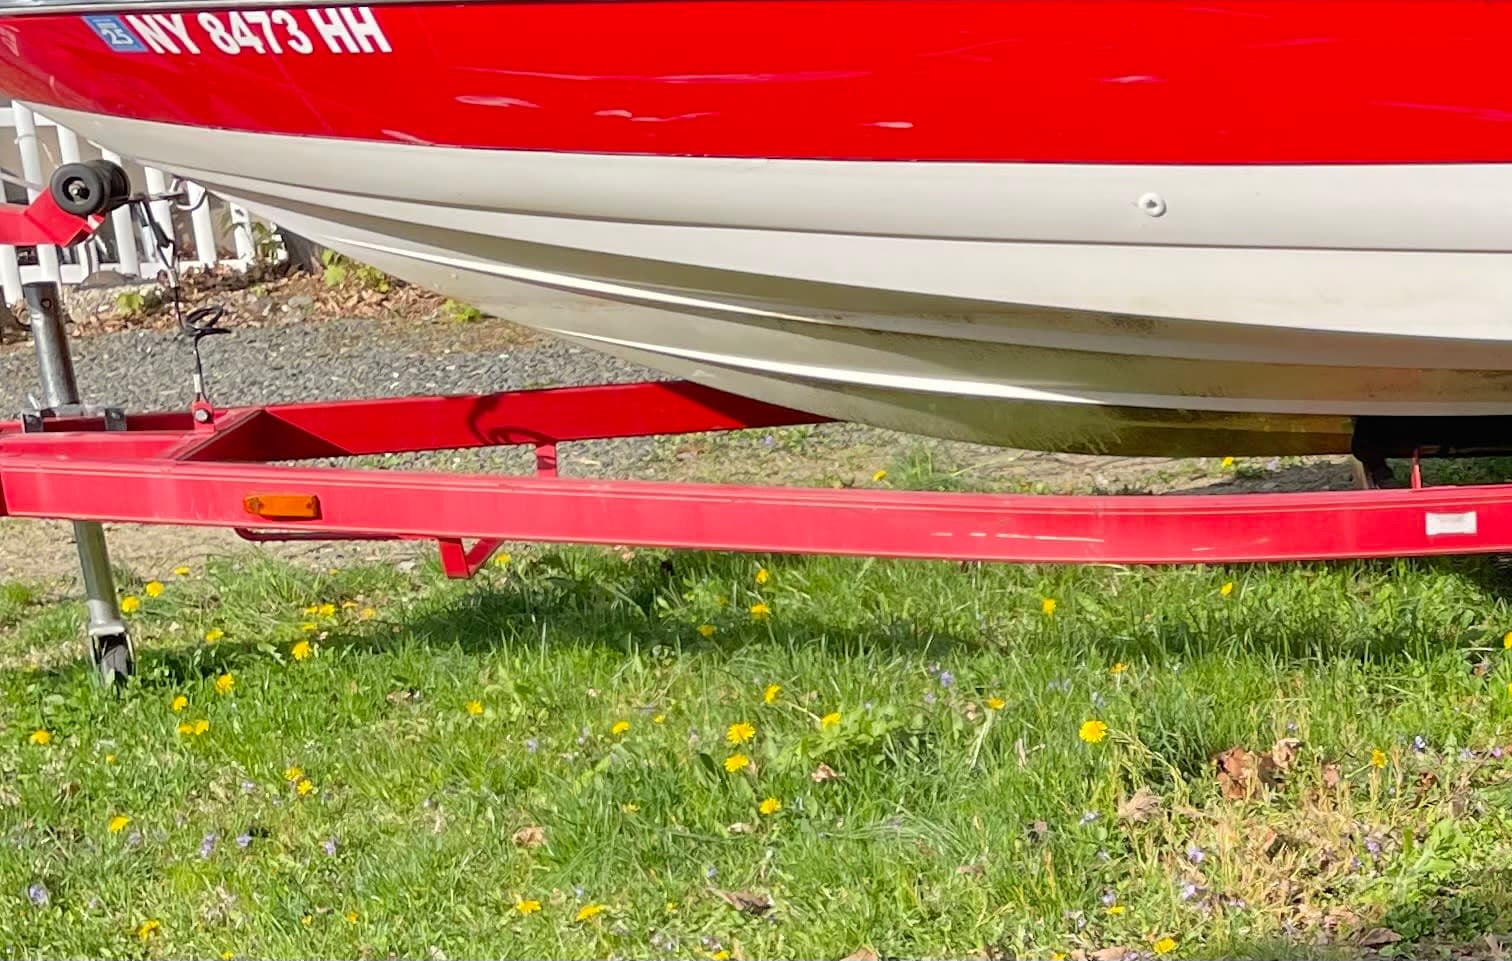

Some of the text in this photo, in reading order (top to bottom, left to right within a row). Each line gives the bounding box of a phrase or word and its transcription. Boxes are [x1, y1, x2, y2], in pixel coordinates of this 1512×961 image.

[100, 28, 134, 45] 25
[125, 7, 392, 54] NY 8473 HH
